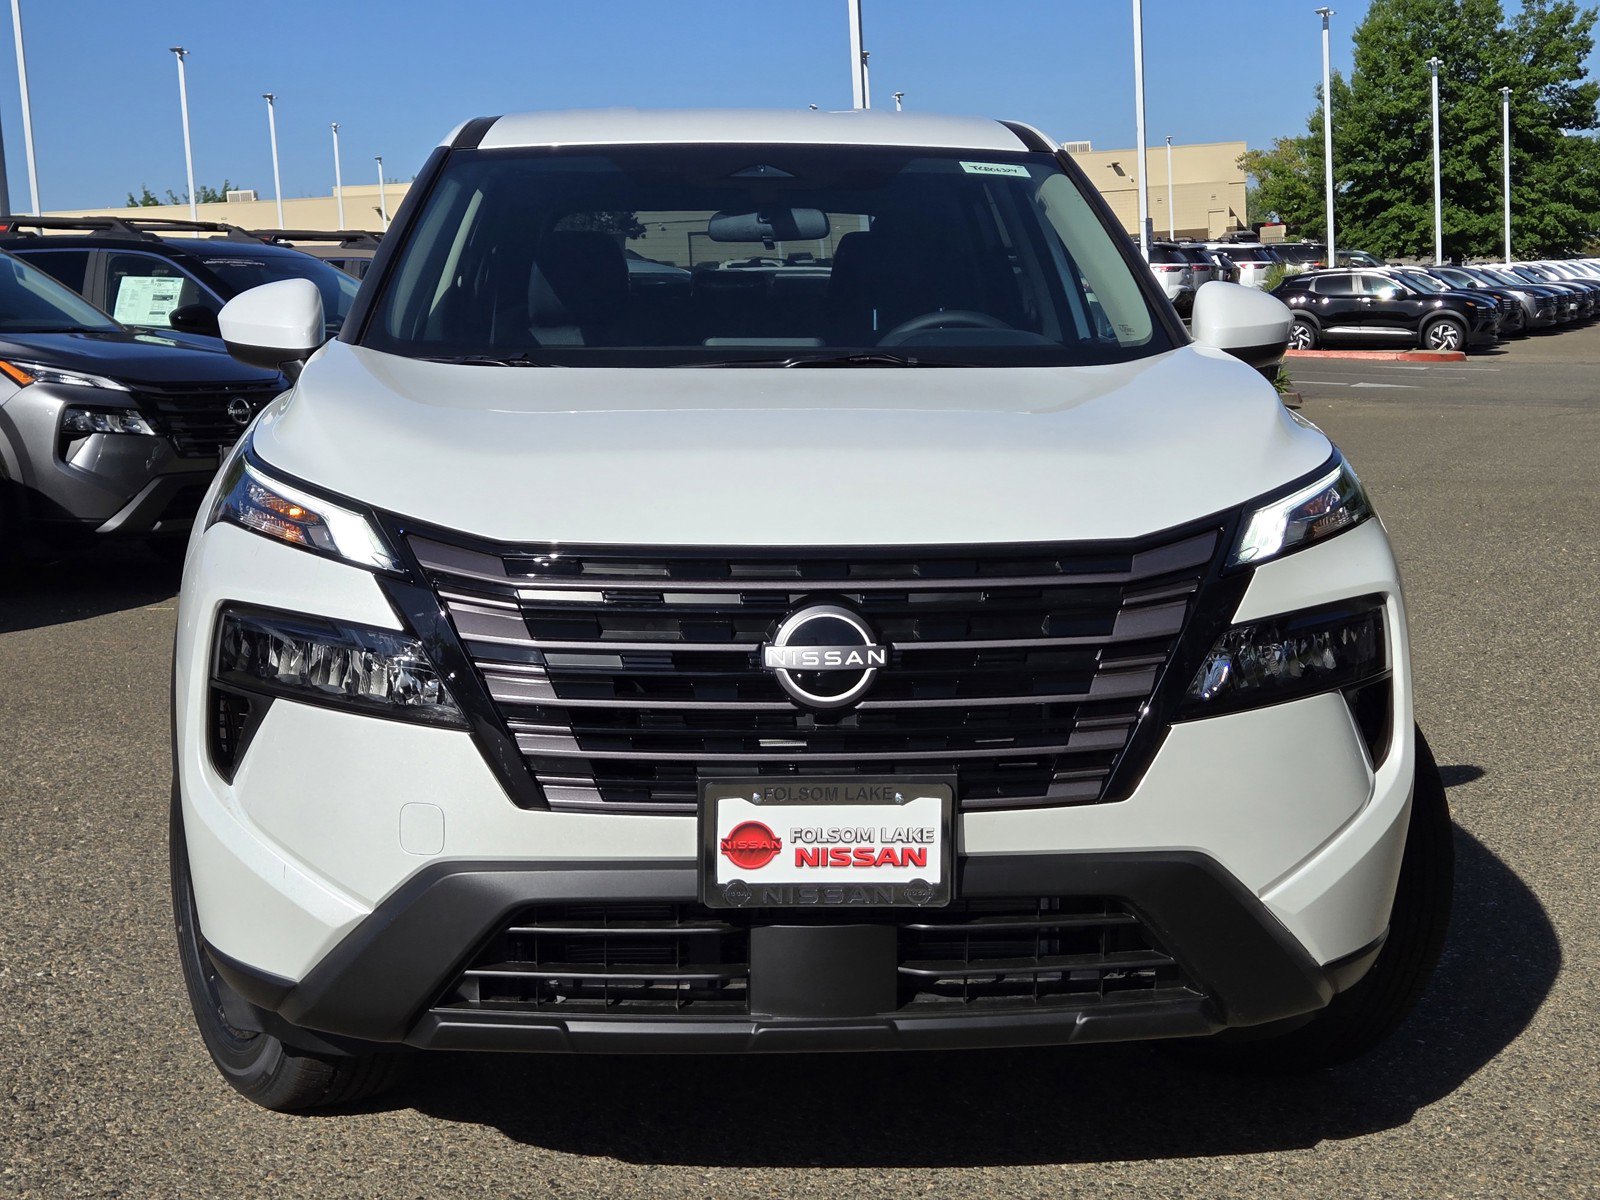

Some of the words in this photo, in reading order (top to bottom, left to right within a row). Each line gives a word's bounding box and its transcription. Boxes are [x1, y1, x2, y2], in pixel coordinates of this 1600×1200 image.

[768, 649, 885, 666] NISSAN
[763, 786, 845, 801] FOLSOM
[847, 786, 893, 801] LAKE
[789, 826, 875, 844] FOLSOM
[881, 826, 935, 844] LAKE
[720, 840, 782, 849] NISSAN
[794, 846, 928, 868] NISSAN
[762, 886, 895, 904] NISSAN
